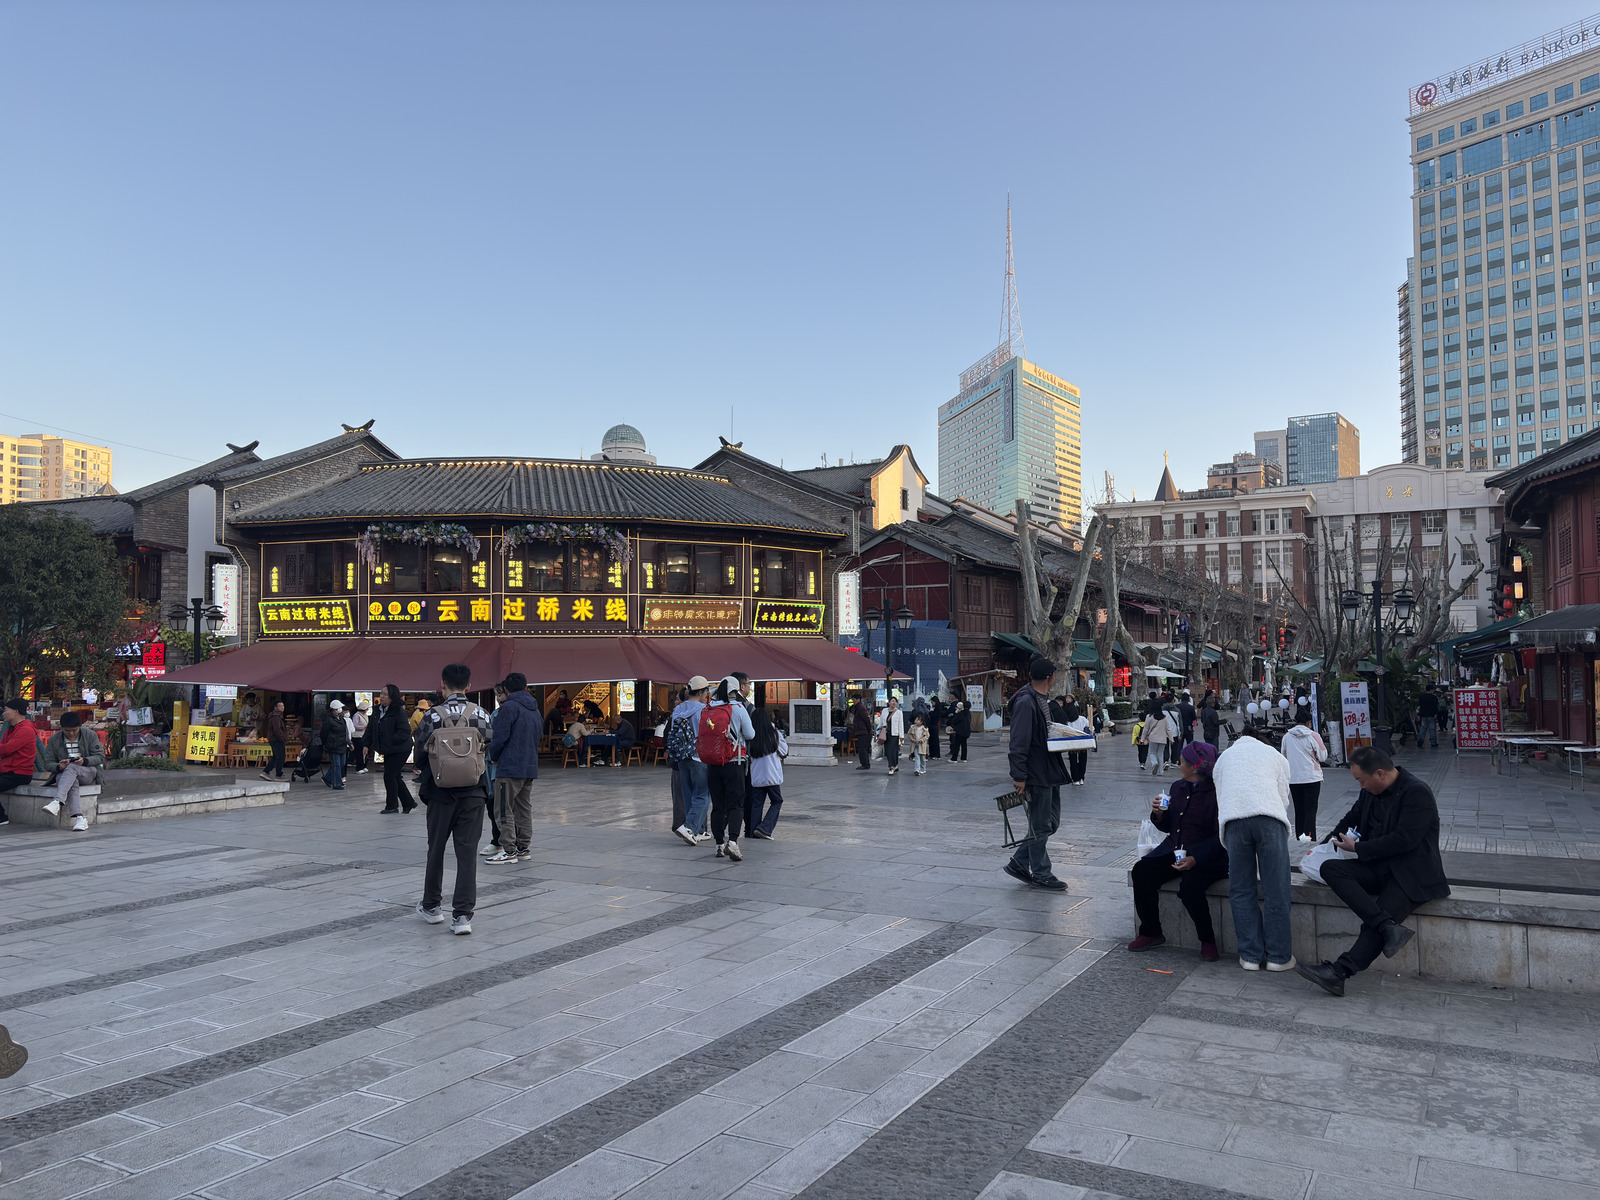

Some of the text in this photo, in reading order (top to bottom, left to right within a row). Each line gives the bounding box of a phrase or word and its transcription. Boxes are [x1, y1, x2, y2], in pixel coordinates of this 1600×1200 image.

[1520, 39, 1565, 66] BANK
[1569, 29, 1590, 46] OF
[1445, 56, 1512, 93] 中国银行
[515, 560, 523, 587] 过桥米线
[266, 606, 345, 621] 云南过桥米线
[437, 597, 628, 622] 云南过桥米线
[662, 609, 737, 620] 非物质文化遗产
[761, 612, 817, 623] 云南传统名小吃
[1457, 692, 1475, 706] 押
[1479, 691, 1496, 699] 高价
[1479, 699, 1497, 707] 回收
[191, 730, 216, 742] 烤乳扇
[190, 745, 215, 756] 奶白酒
